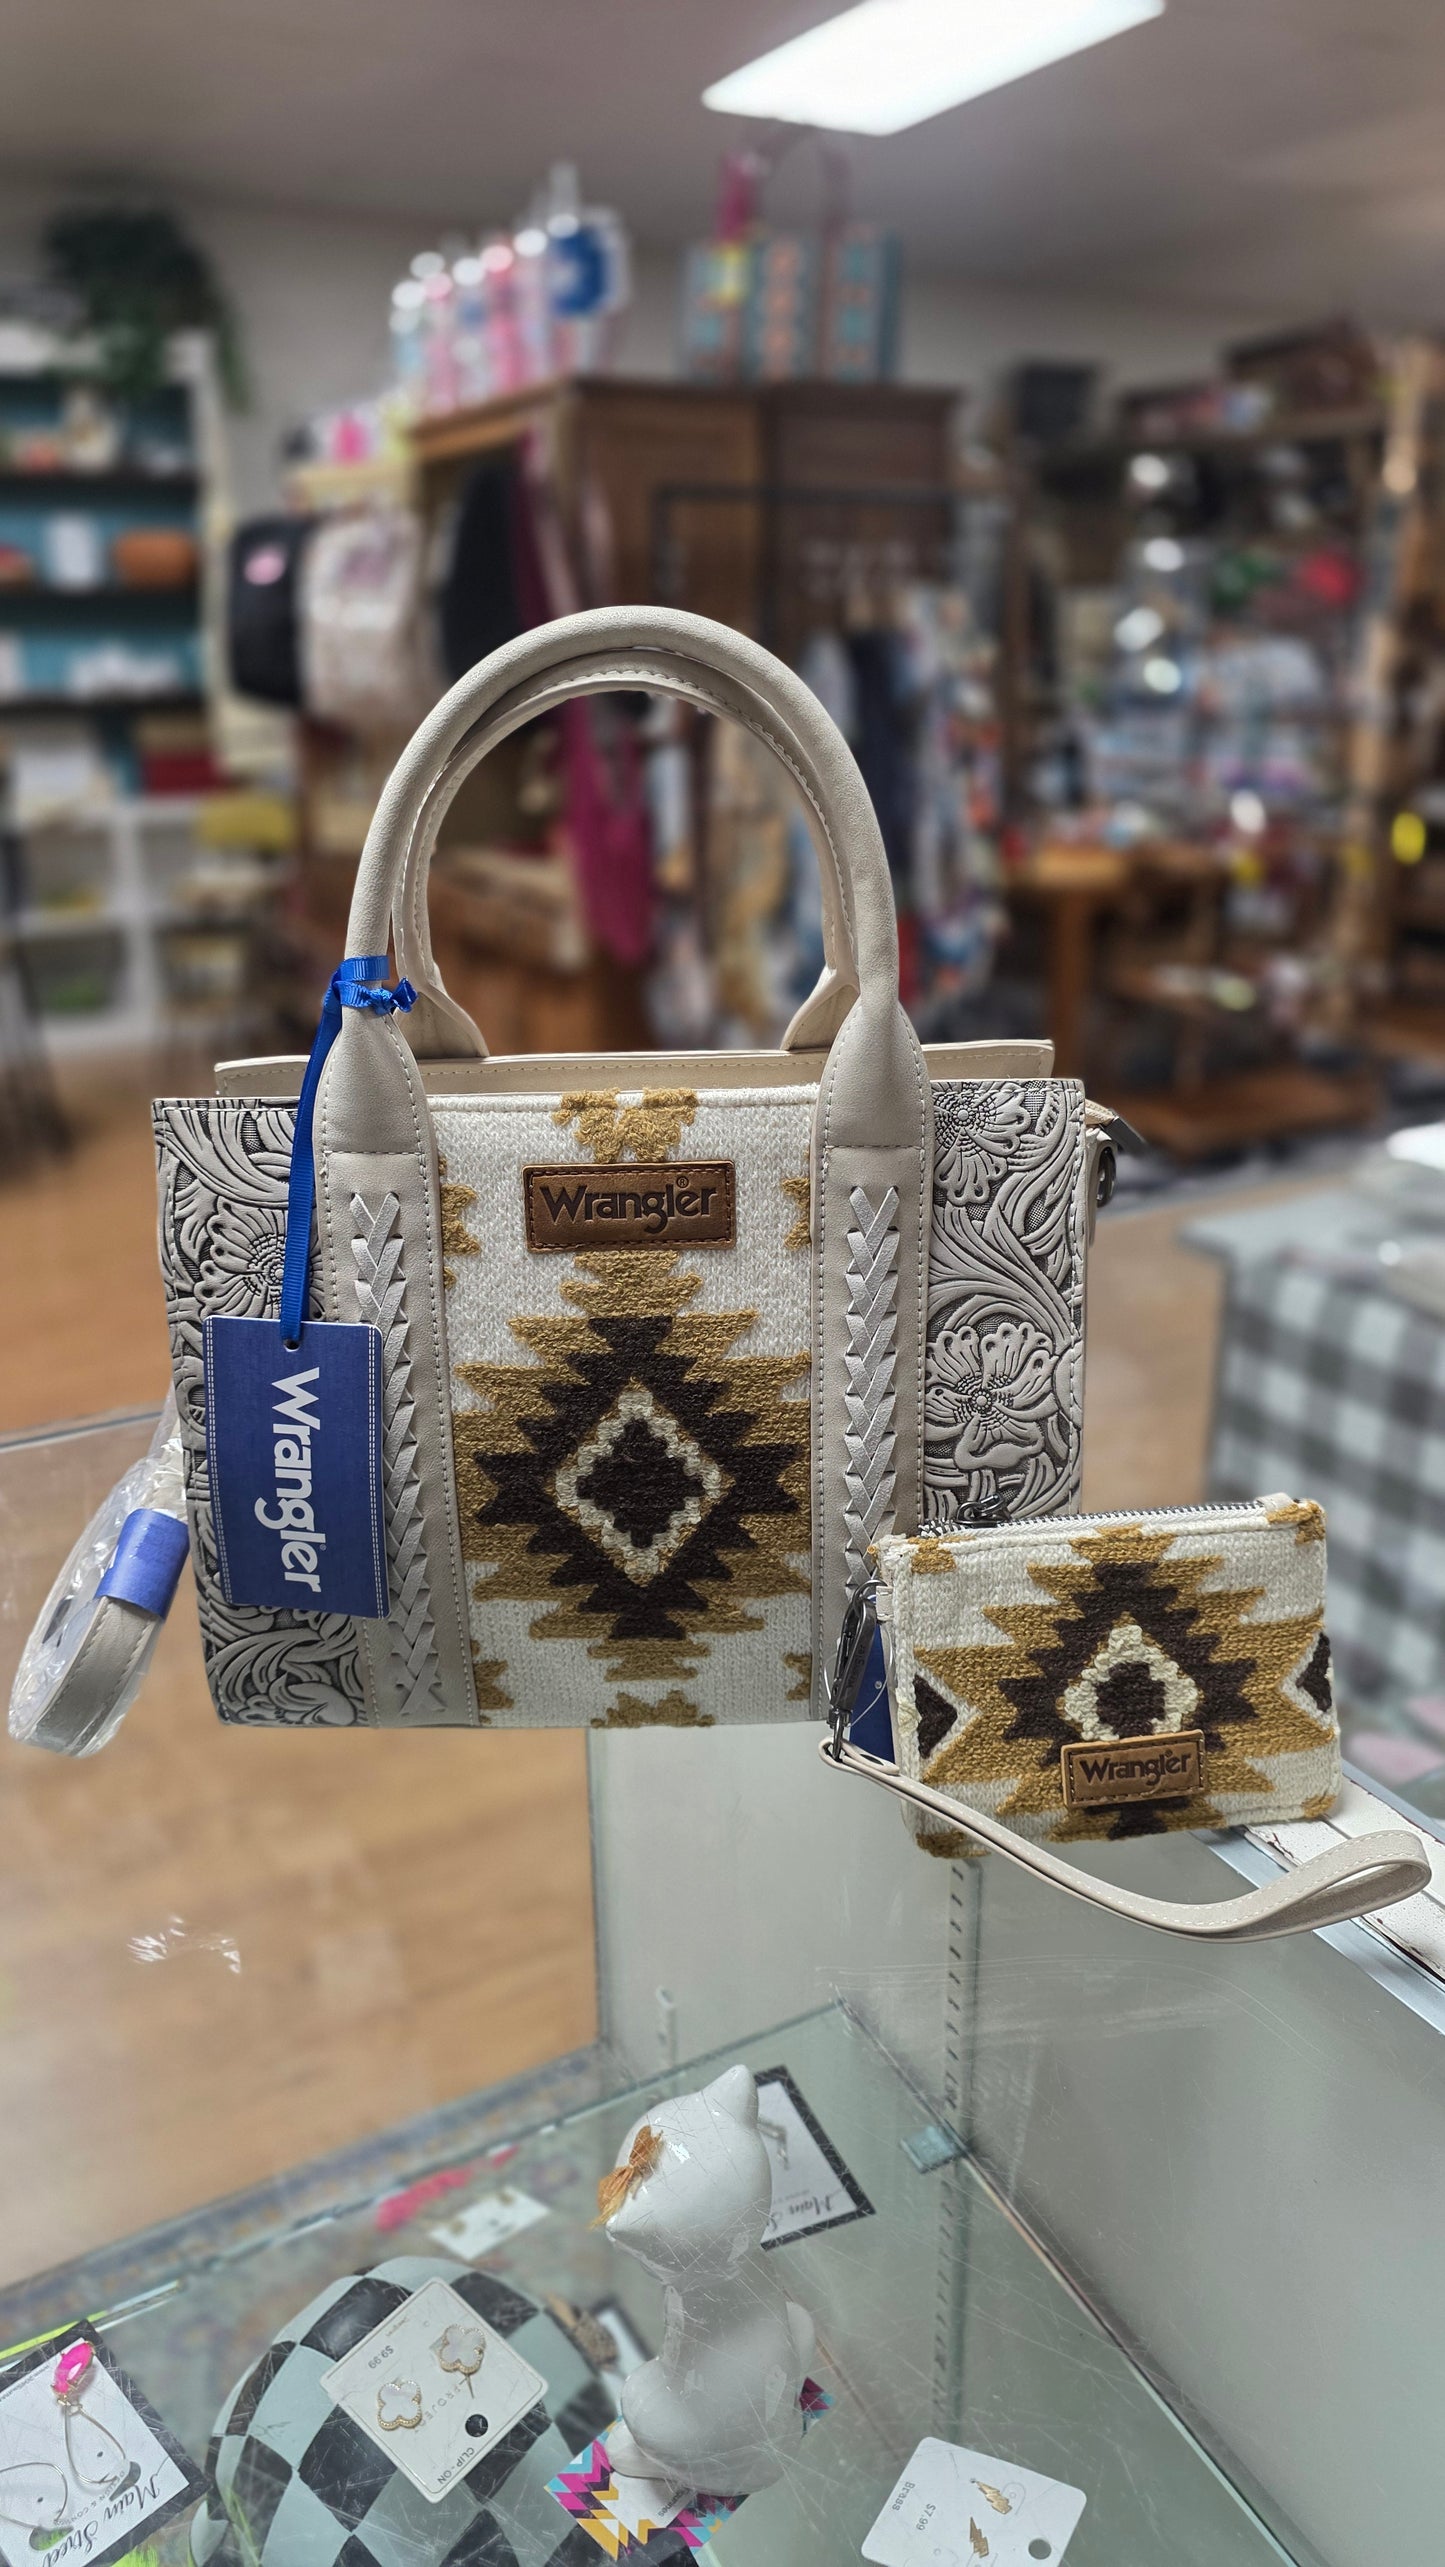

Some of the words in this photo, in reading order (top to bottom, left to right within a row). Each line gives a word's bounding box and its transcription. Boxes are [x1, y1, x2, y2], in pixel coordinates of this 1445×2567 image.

[540, 1183, 717, 1234] Wrangler
[254, 1366, 326, 1594] Wrangler
[1079, 1752, 1192, 1787] Wrangler
[367, 2344, 395, 2370] $9.99
[103, 2473, 161, 2521] Main
[891, 2481, 916, 2511] Brass
[915, 2503, 937, 2531] $7.99
